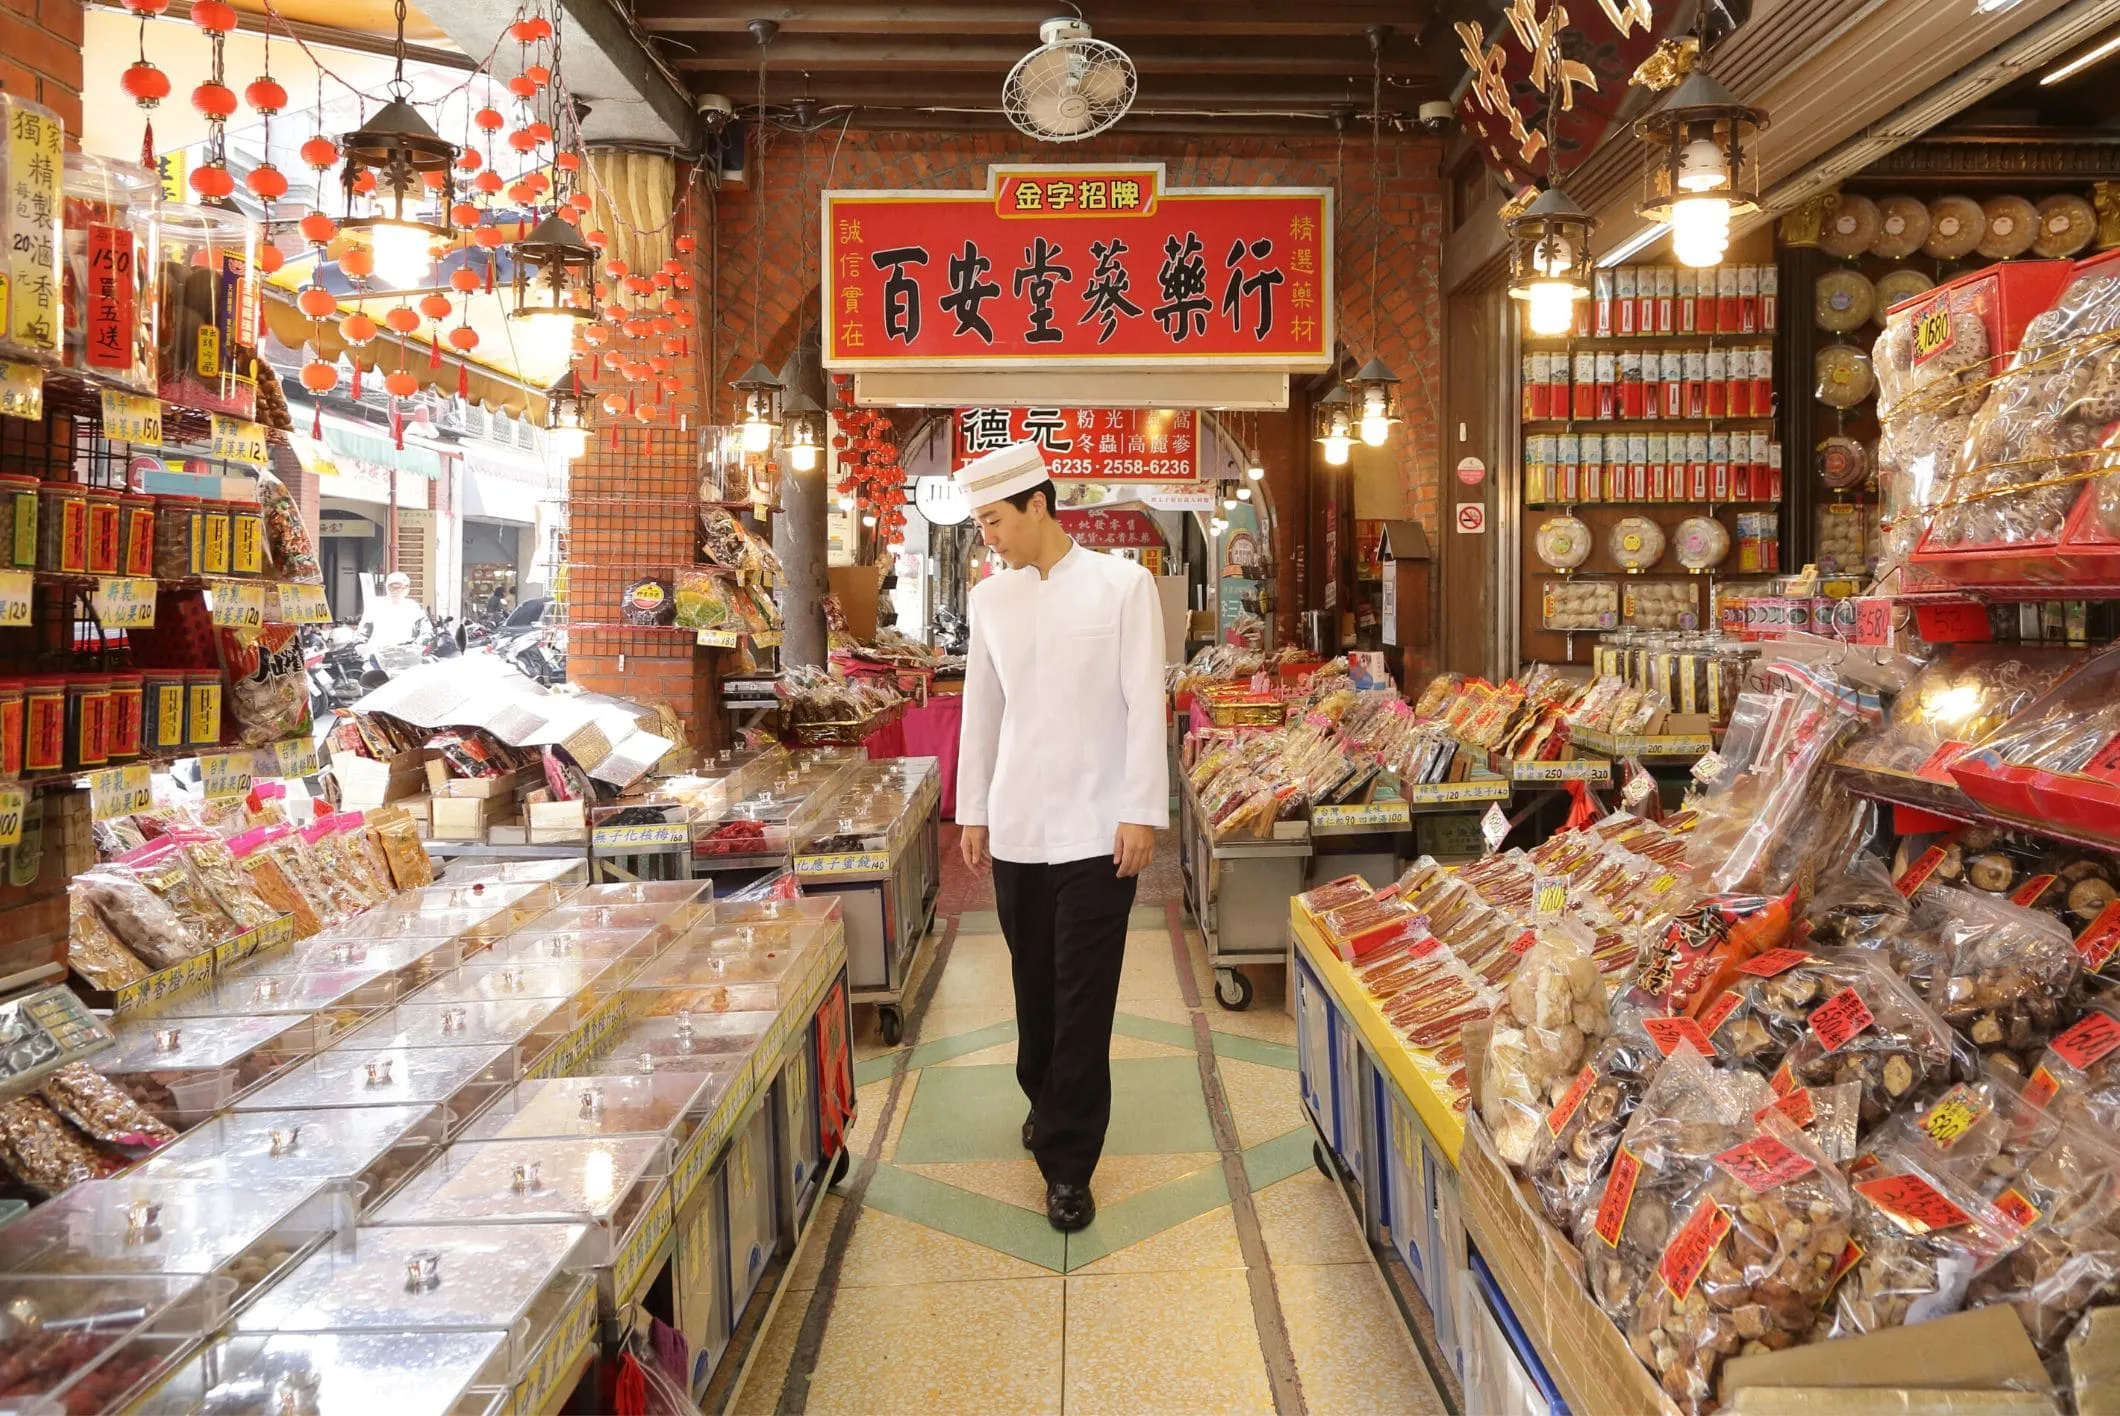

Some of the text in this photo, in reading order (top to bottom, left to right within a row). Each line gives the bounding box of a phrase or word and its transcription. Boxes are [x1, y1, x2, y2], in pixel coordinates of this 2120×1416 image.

[1014, 181, 1141, 210] 金字招牌
[93, 248, 129, 273] 150
[840, 218, 865, 347] 誠信實在
[871, 231, 1285, 345] 百安堂蔘藥行
[1289, 215, 1316, 343] 精選藥材
[143, 417, 159, 440] 150
[1077, 409, 1123, 429] 粉光
[959, 408, 1073, 453] 德元
[1077, 434, 1118, 454] 冬蟲
[1046, 459, 1190, 475] -6235 2558-6236
[9, 602, 27, 620] 120
[103, 604, 151, 623] 八仙果 120
[244, 607, 259, 625] 120
[1545, 768, 1563, 779] 250
[133, 788, 150, 808] 120
